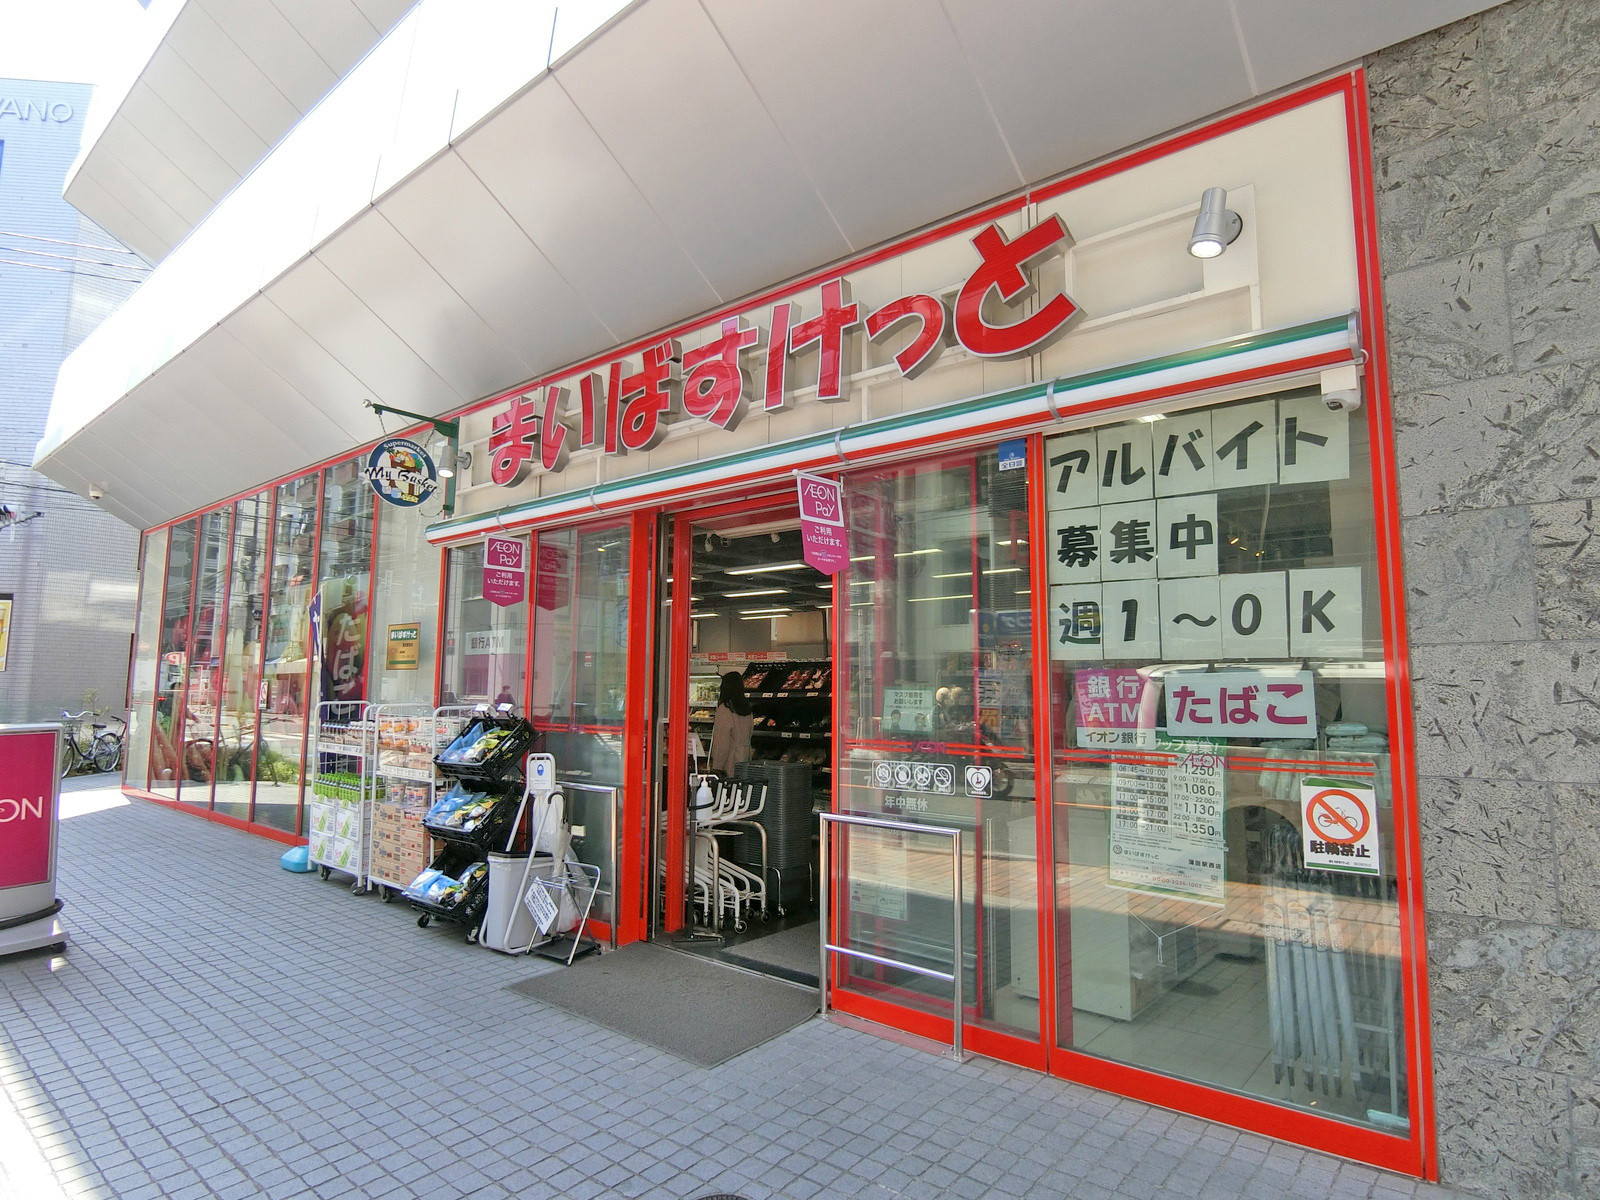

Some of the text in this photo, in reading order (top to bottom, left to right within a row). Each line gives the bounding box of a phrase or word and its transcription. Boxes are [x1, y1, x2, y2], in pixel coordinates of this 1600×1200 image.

[0, 97, 74, 123] ANO
[489, 213, 1085, 487] まいばすけっと
[384, 441, 427, 458] Supermarket
[1050, 416, 1329, 493] アルバイト
[365, 467, 438, 493] My Basket
[815, 501, 835, 517] Pay
[814, 526, 833, 536] ご利用
[1057, 513, 1214, 568] 募集中
[500, 554, 519, 566] Pay
[1087, 675, 1140, 699] 銀行
[1088, 702, 1142, 723] ATM
[1172, 683, 1308, 725] たばこ
[1085, 731, 1147, 745] イオン銀行
[0, 796, 43, 823] ON
[884, 795, 929, 812] 年中無休
[1310, 840, 1371, 858] 駐輪禁止
